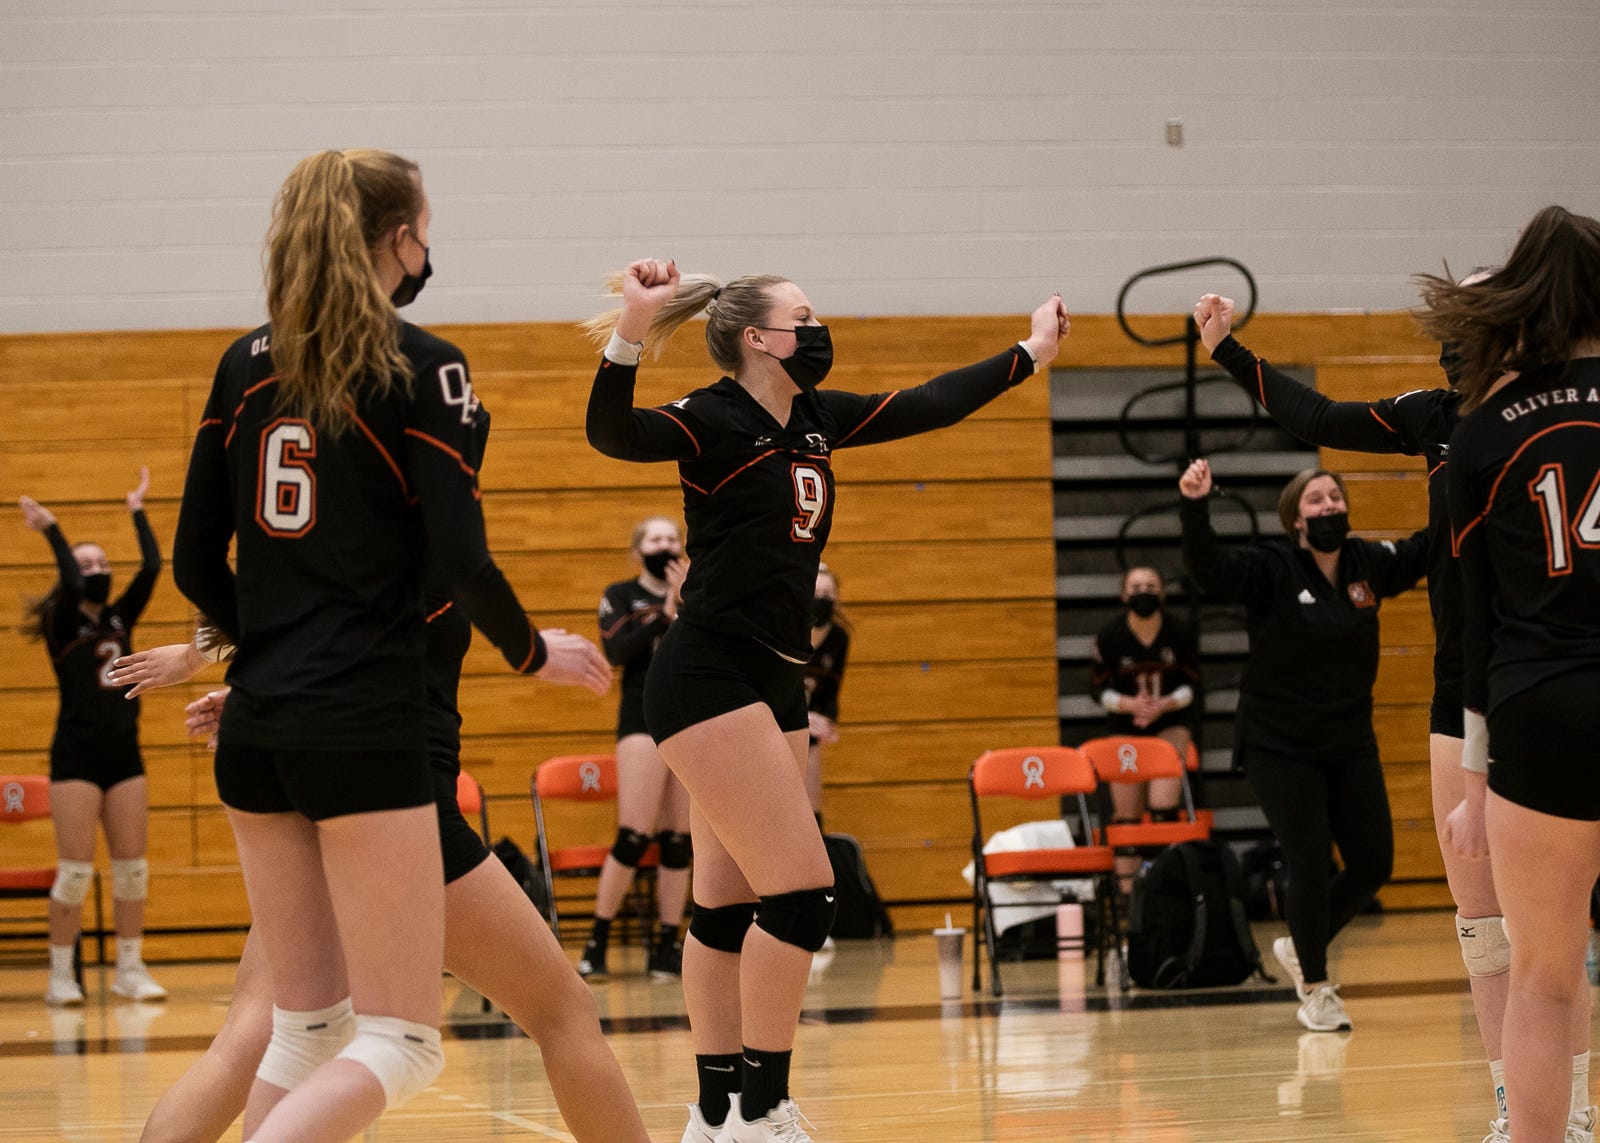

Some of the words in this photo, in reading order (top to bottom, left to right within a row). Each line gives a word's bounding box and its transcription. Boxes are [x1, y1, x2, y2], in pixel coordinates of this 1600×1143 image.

[1502, 388, 1579, 421] OLIVER
[256, 418, 316, 538] 6
[790, 463, 828, 542] 9
[97, 640, 122, 688] 2
